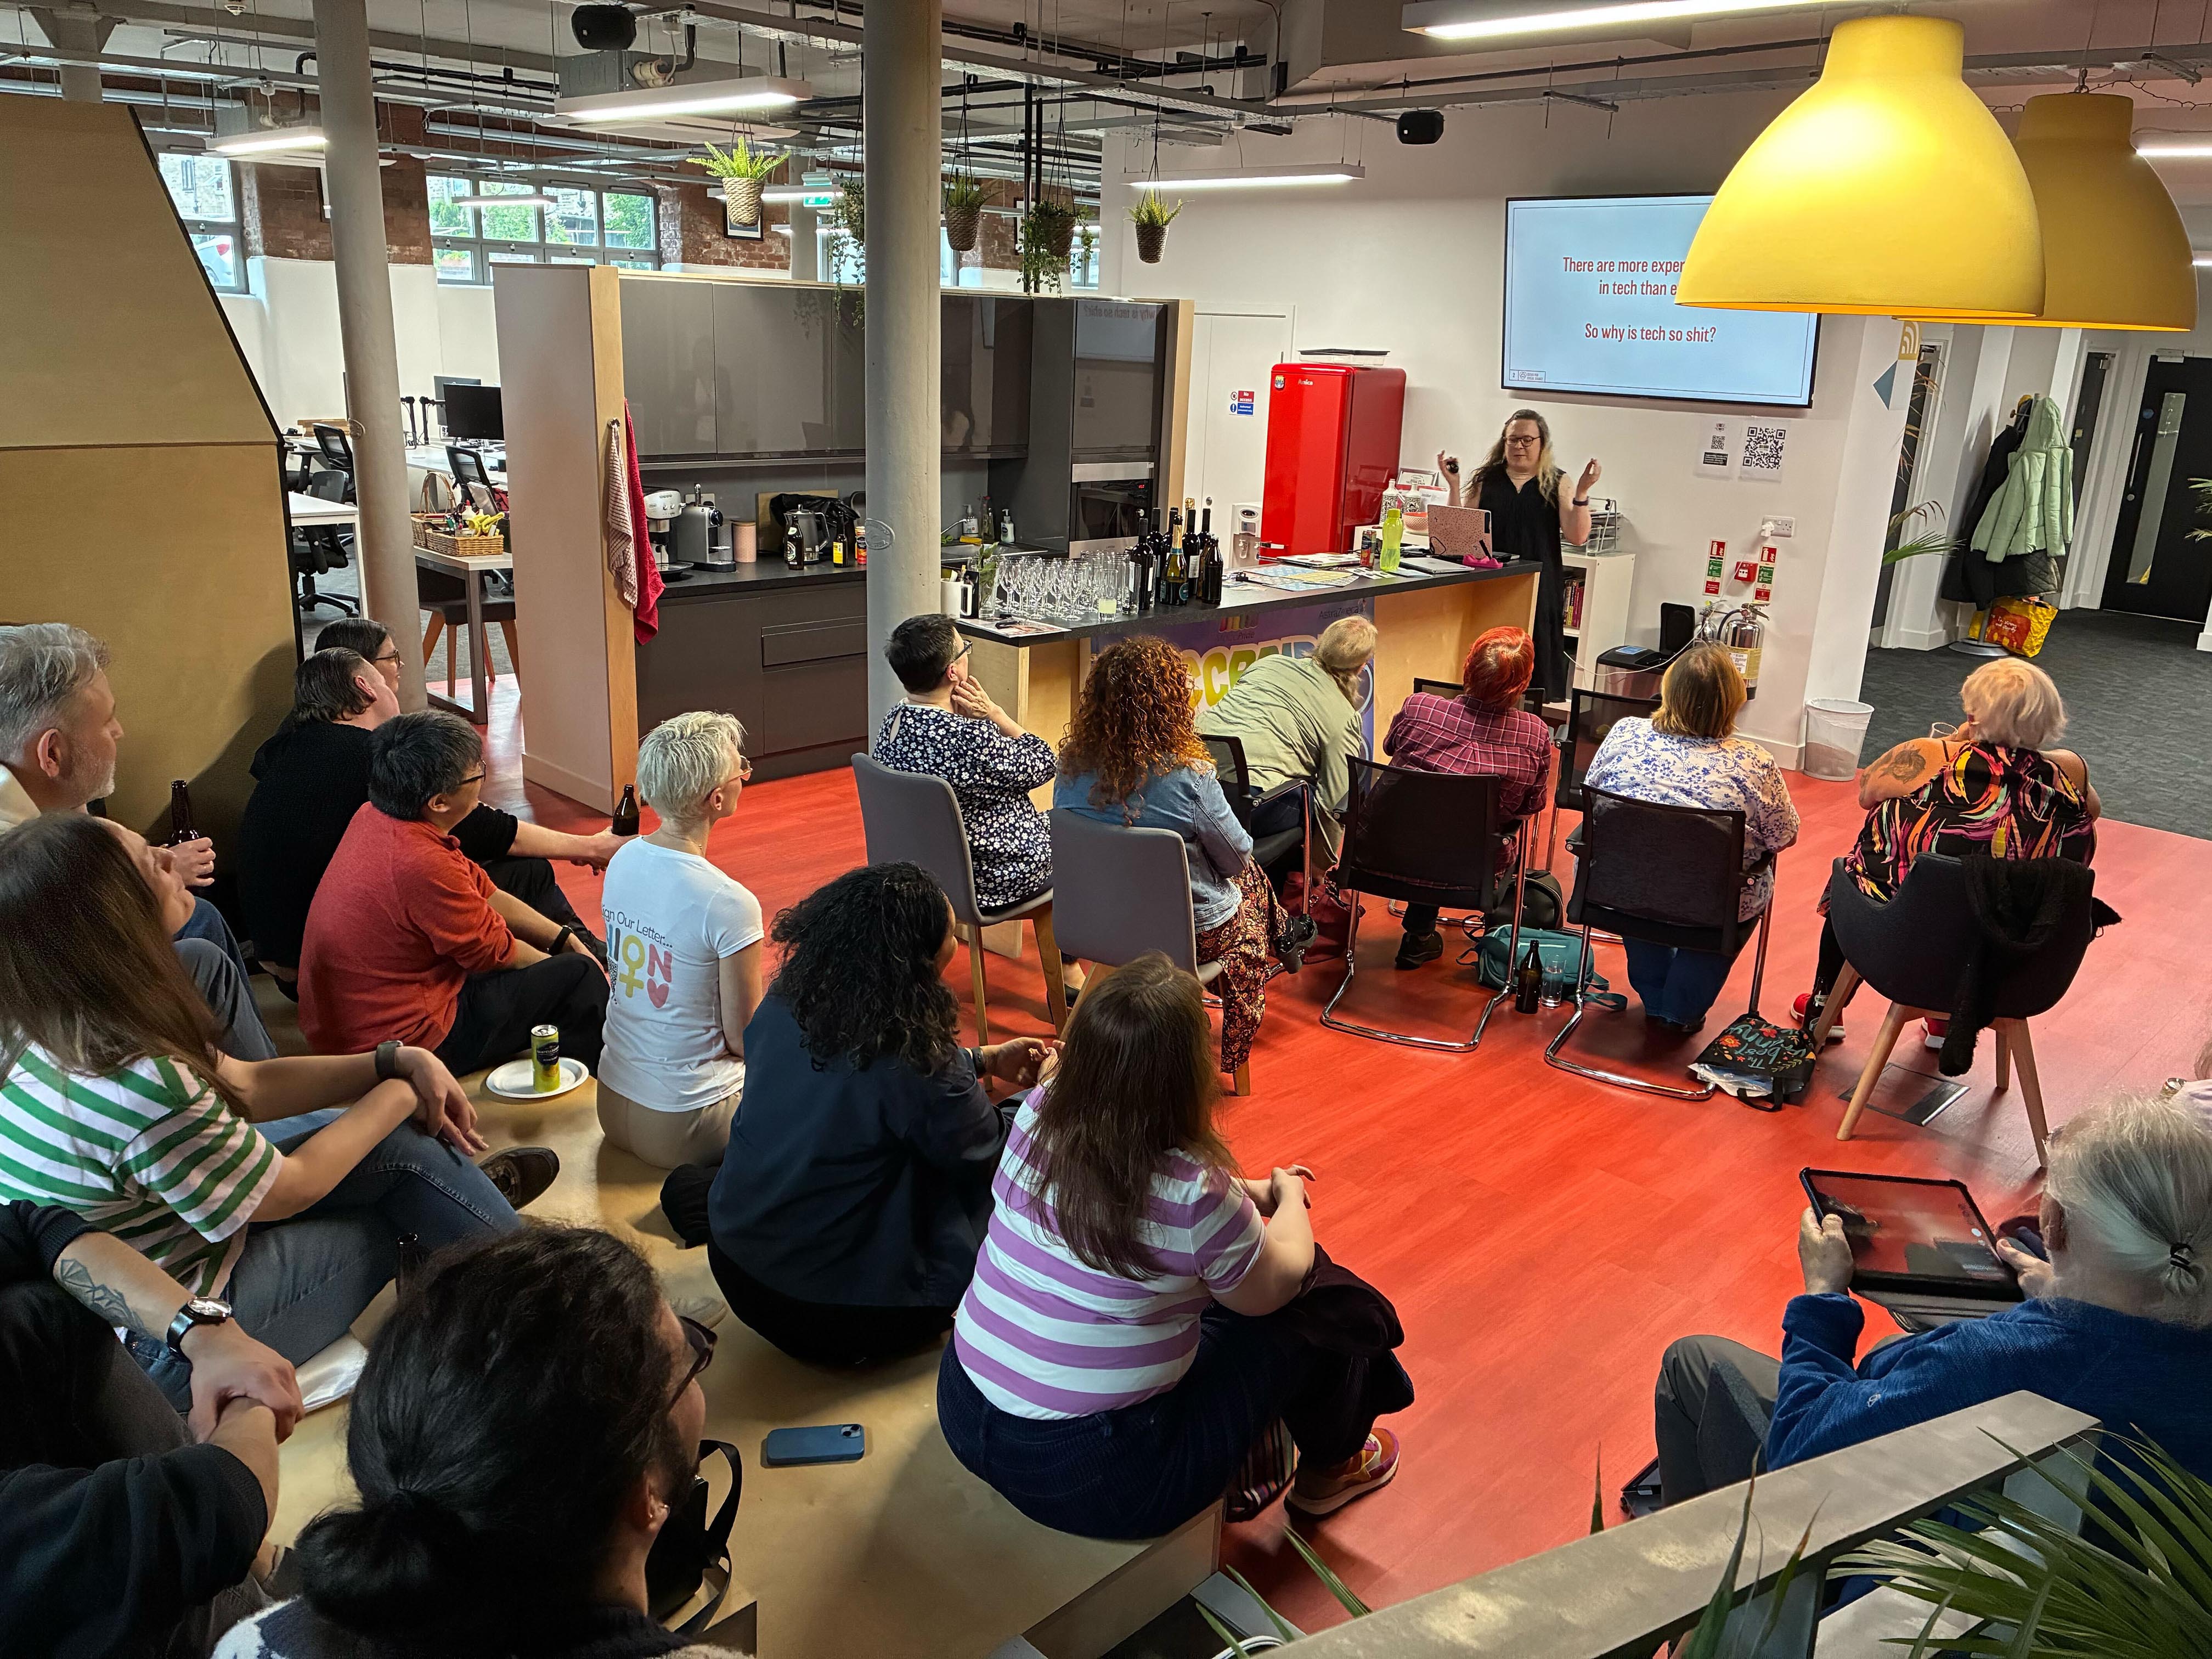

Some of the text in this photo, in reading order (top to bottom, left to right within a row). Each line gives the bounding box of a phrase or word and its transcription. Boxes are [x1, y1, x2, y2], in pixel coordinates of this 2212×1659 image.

[1563, 257, 1685, 275] There are more exper
[1599, 279, 1678, 296] in tech than e
[1585, 323, 1717, 342] So why is tech so shit?
[602, 905, 673, 948] ign Our Letter...
[1734, 1042, 1781, 1064] best
[1747, 1057, 1765, 1069] The
